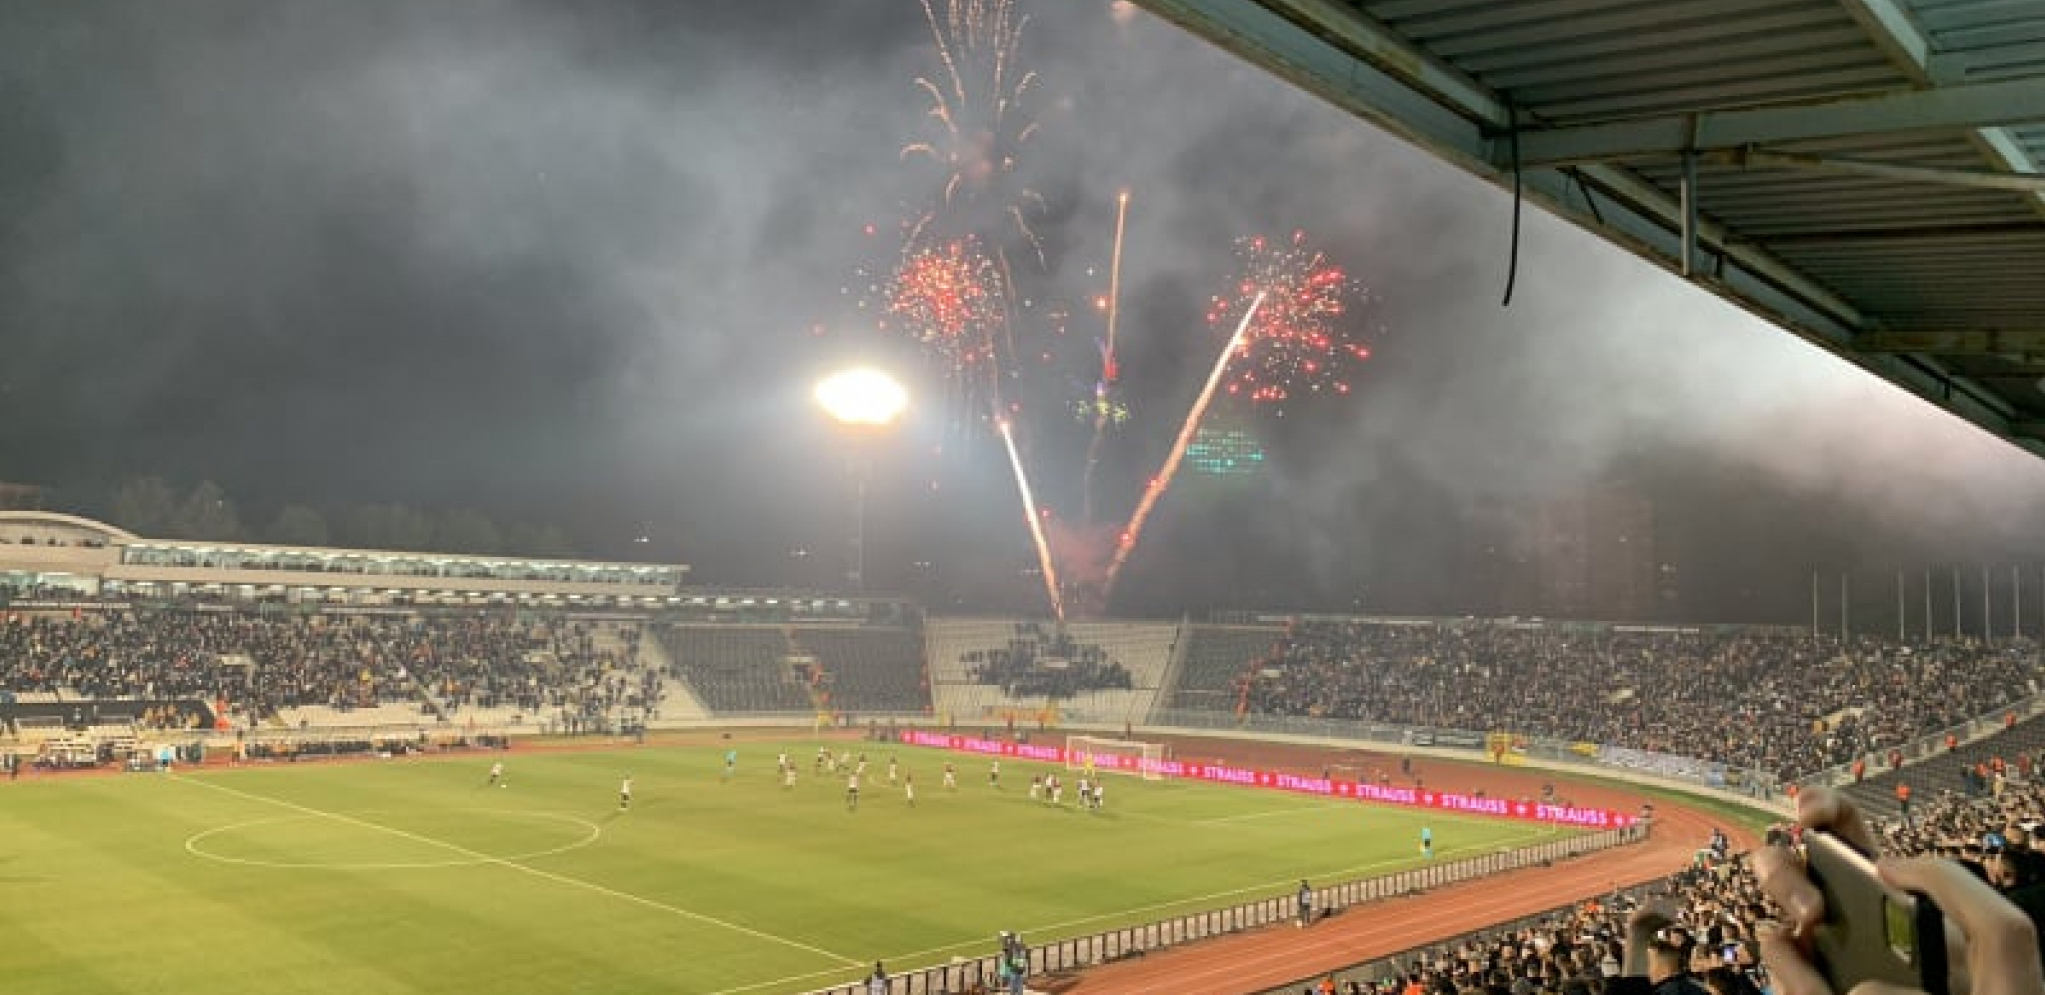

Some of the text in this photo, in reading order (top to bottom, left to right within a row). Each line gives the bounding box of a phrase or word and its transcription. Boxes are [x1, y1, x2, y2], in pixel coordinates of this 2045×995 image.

[1204, 766, 1254, 783] STRAUSS
[1278, 774, 1330, 792] STRAUSS
[1357, 784, 1415, 802] STRAUSS
[1442, 794, 1507, 814] STRAUSS
[1536, 804, 1607, 824] STRAUSS
